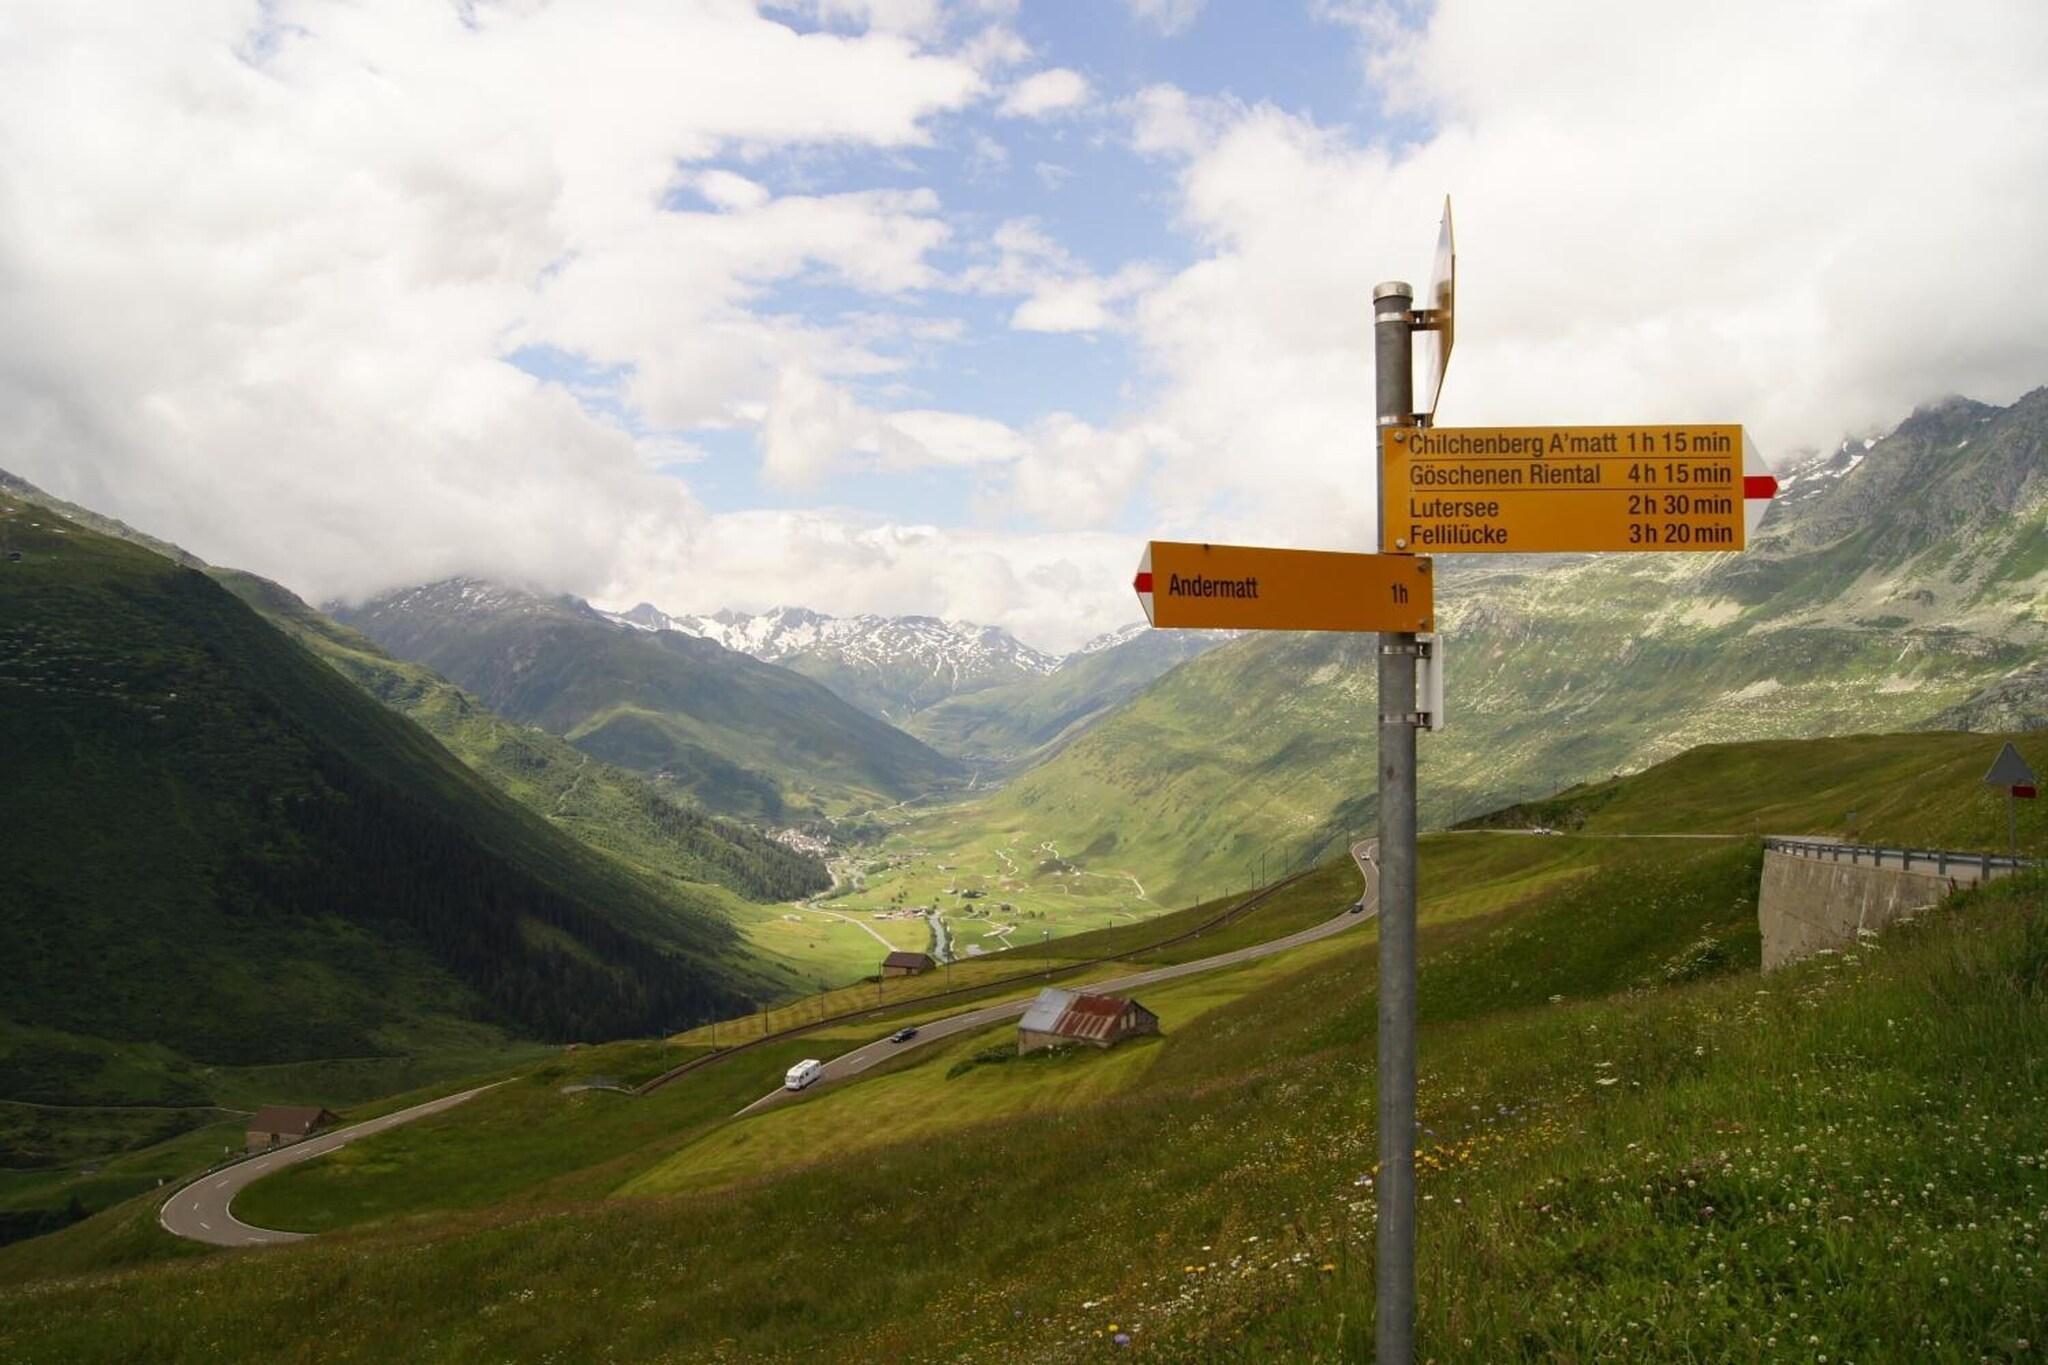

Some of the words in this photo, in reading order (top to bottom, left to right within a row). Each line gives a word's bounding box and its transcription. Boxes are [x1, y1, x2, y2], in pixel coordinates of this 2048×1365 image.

[1409, 433, 1545, 458] Chilchenberg
[1662, 432, 1688, 453] 15
[1692, 431, 1731, 452] min
[1410, 464, 1523, 486] Göschenen
[1530, 463, 1601, 485] Riental
[1410, 497, 1500, 518] Lutersee
[1410, 523, 1508, 545] Fellilücke
[1168, 573, 1259, 599] Andermatt
